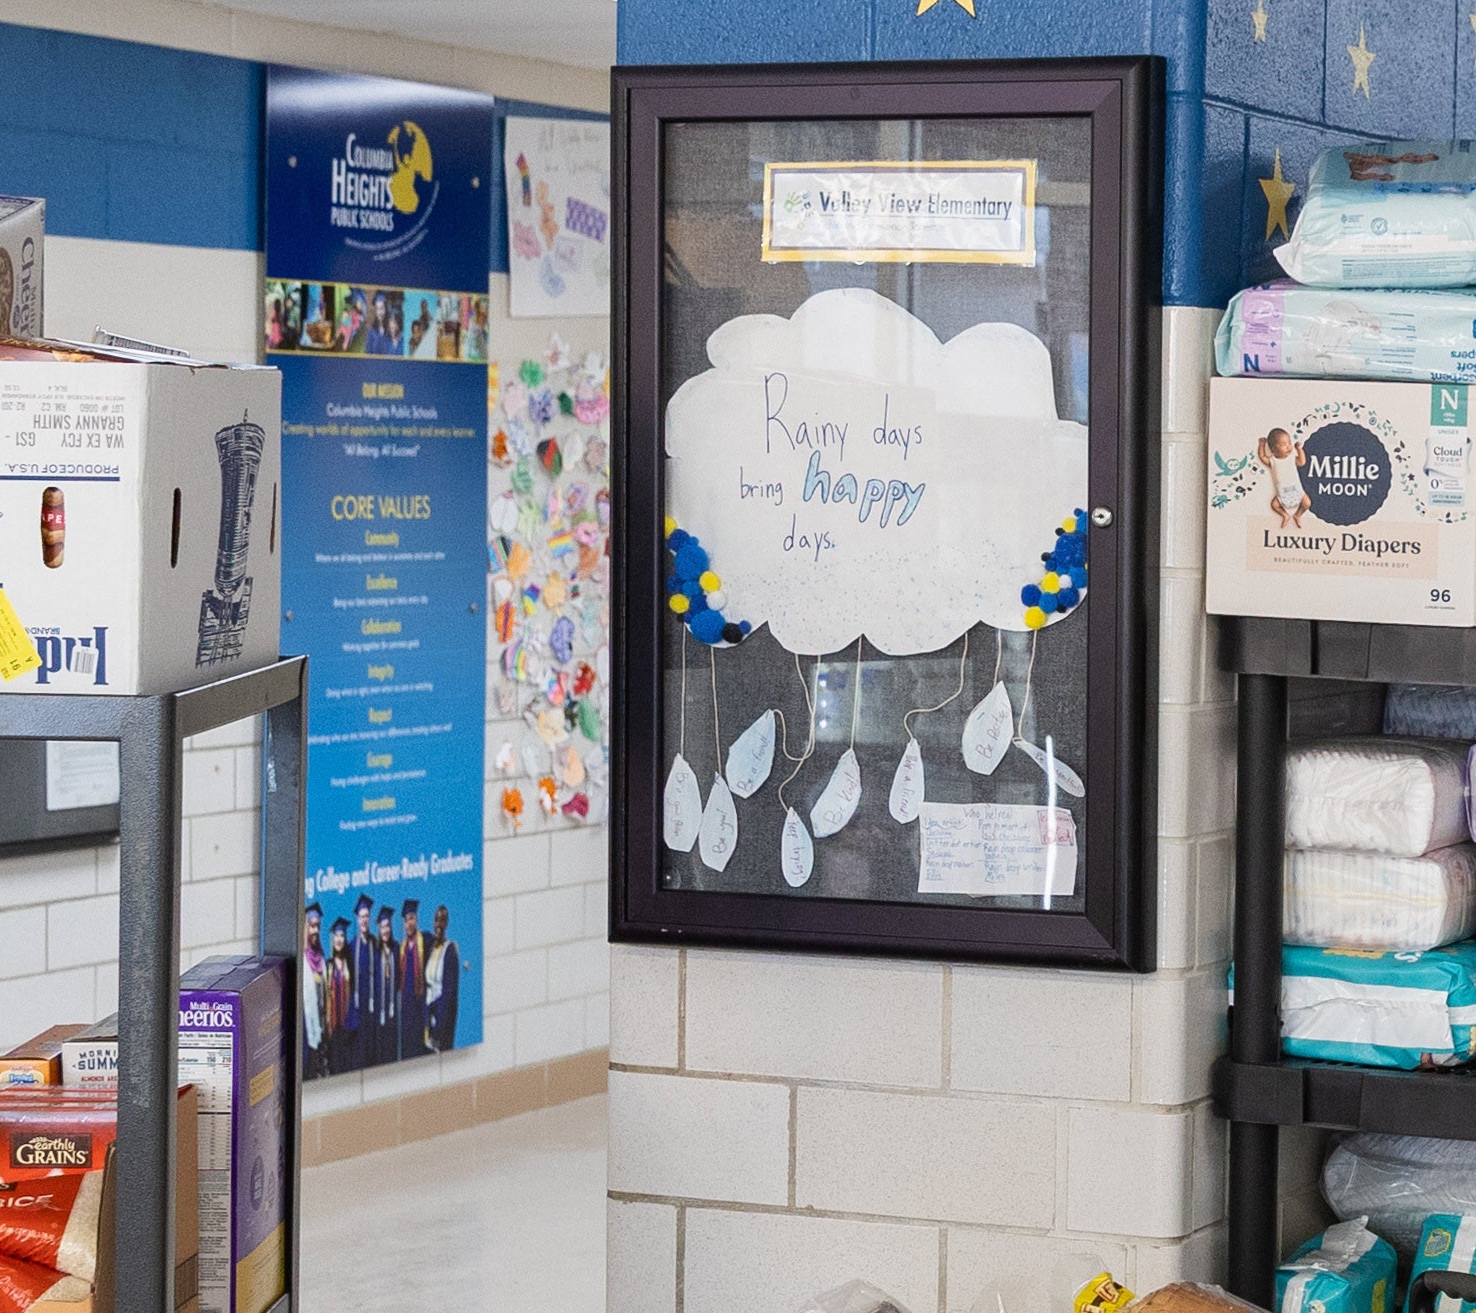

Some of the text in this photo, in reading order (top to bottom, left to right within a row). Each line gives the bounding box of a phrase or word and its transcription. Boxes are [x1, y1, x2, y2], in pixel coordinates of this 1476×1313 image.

[331, 158, 394, 210] HEIGHTS
[818, 190, 1013, 221] Valley View Elementary
[330, 206, 394, 232] PUBLIC SCHOOLS
[1440, 389, 1460, 410] N
[33, 414, 125, 430] GRANNY SMITH
[764, 372, 923, 462] Rainy days
[61, 432, 124, 449] WA EX FCY
[1432, 445, 1463, 457] Cloud
[1307, 454, 1381, 481] Millie
[739, 449, 927, 529] bring happy
[331, 494, 431, 520] CORE VALUES
[782, 513, 837, 563] days.
[1263, 529, 1422, 558] Luxury Diapers
[1273, 556, 1410, 569] BEAUTIFULLY FEATHER SOFT
[1429, 588, 1452, 603] 96
[316, 849, 474, 894] College and Career-Ready Graduates
[15, 1144, 89, 1165] GRAINS
[33, 1138, 76, 1153] earthly
